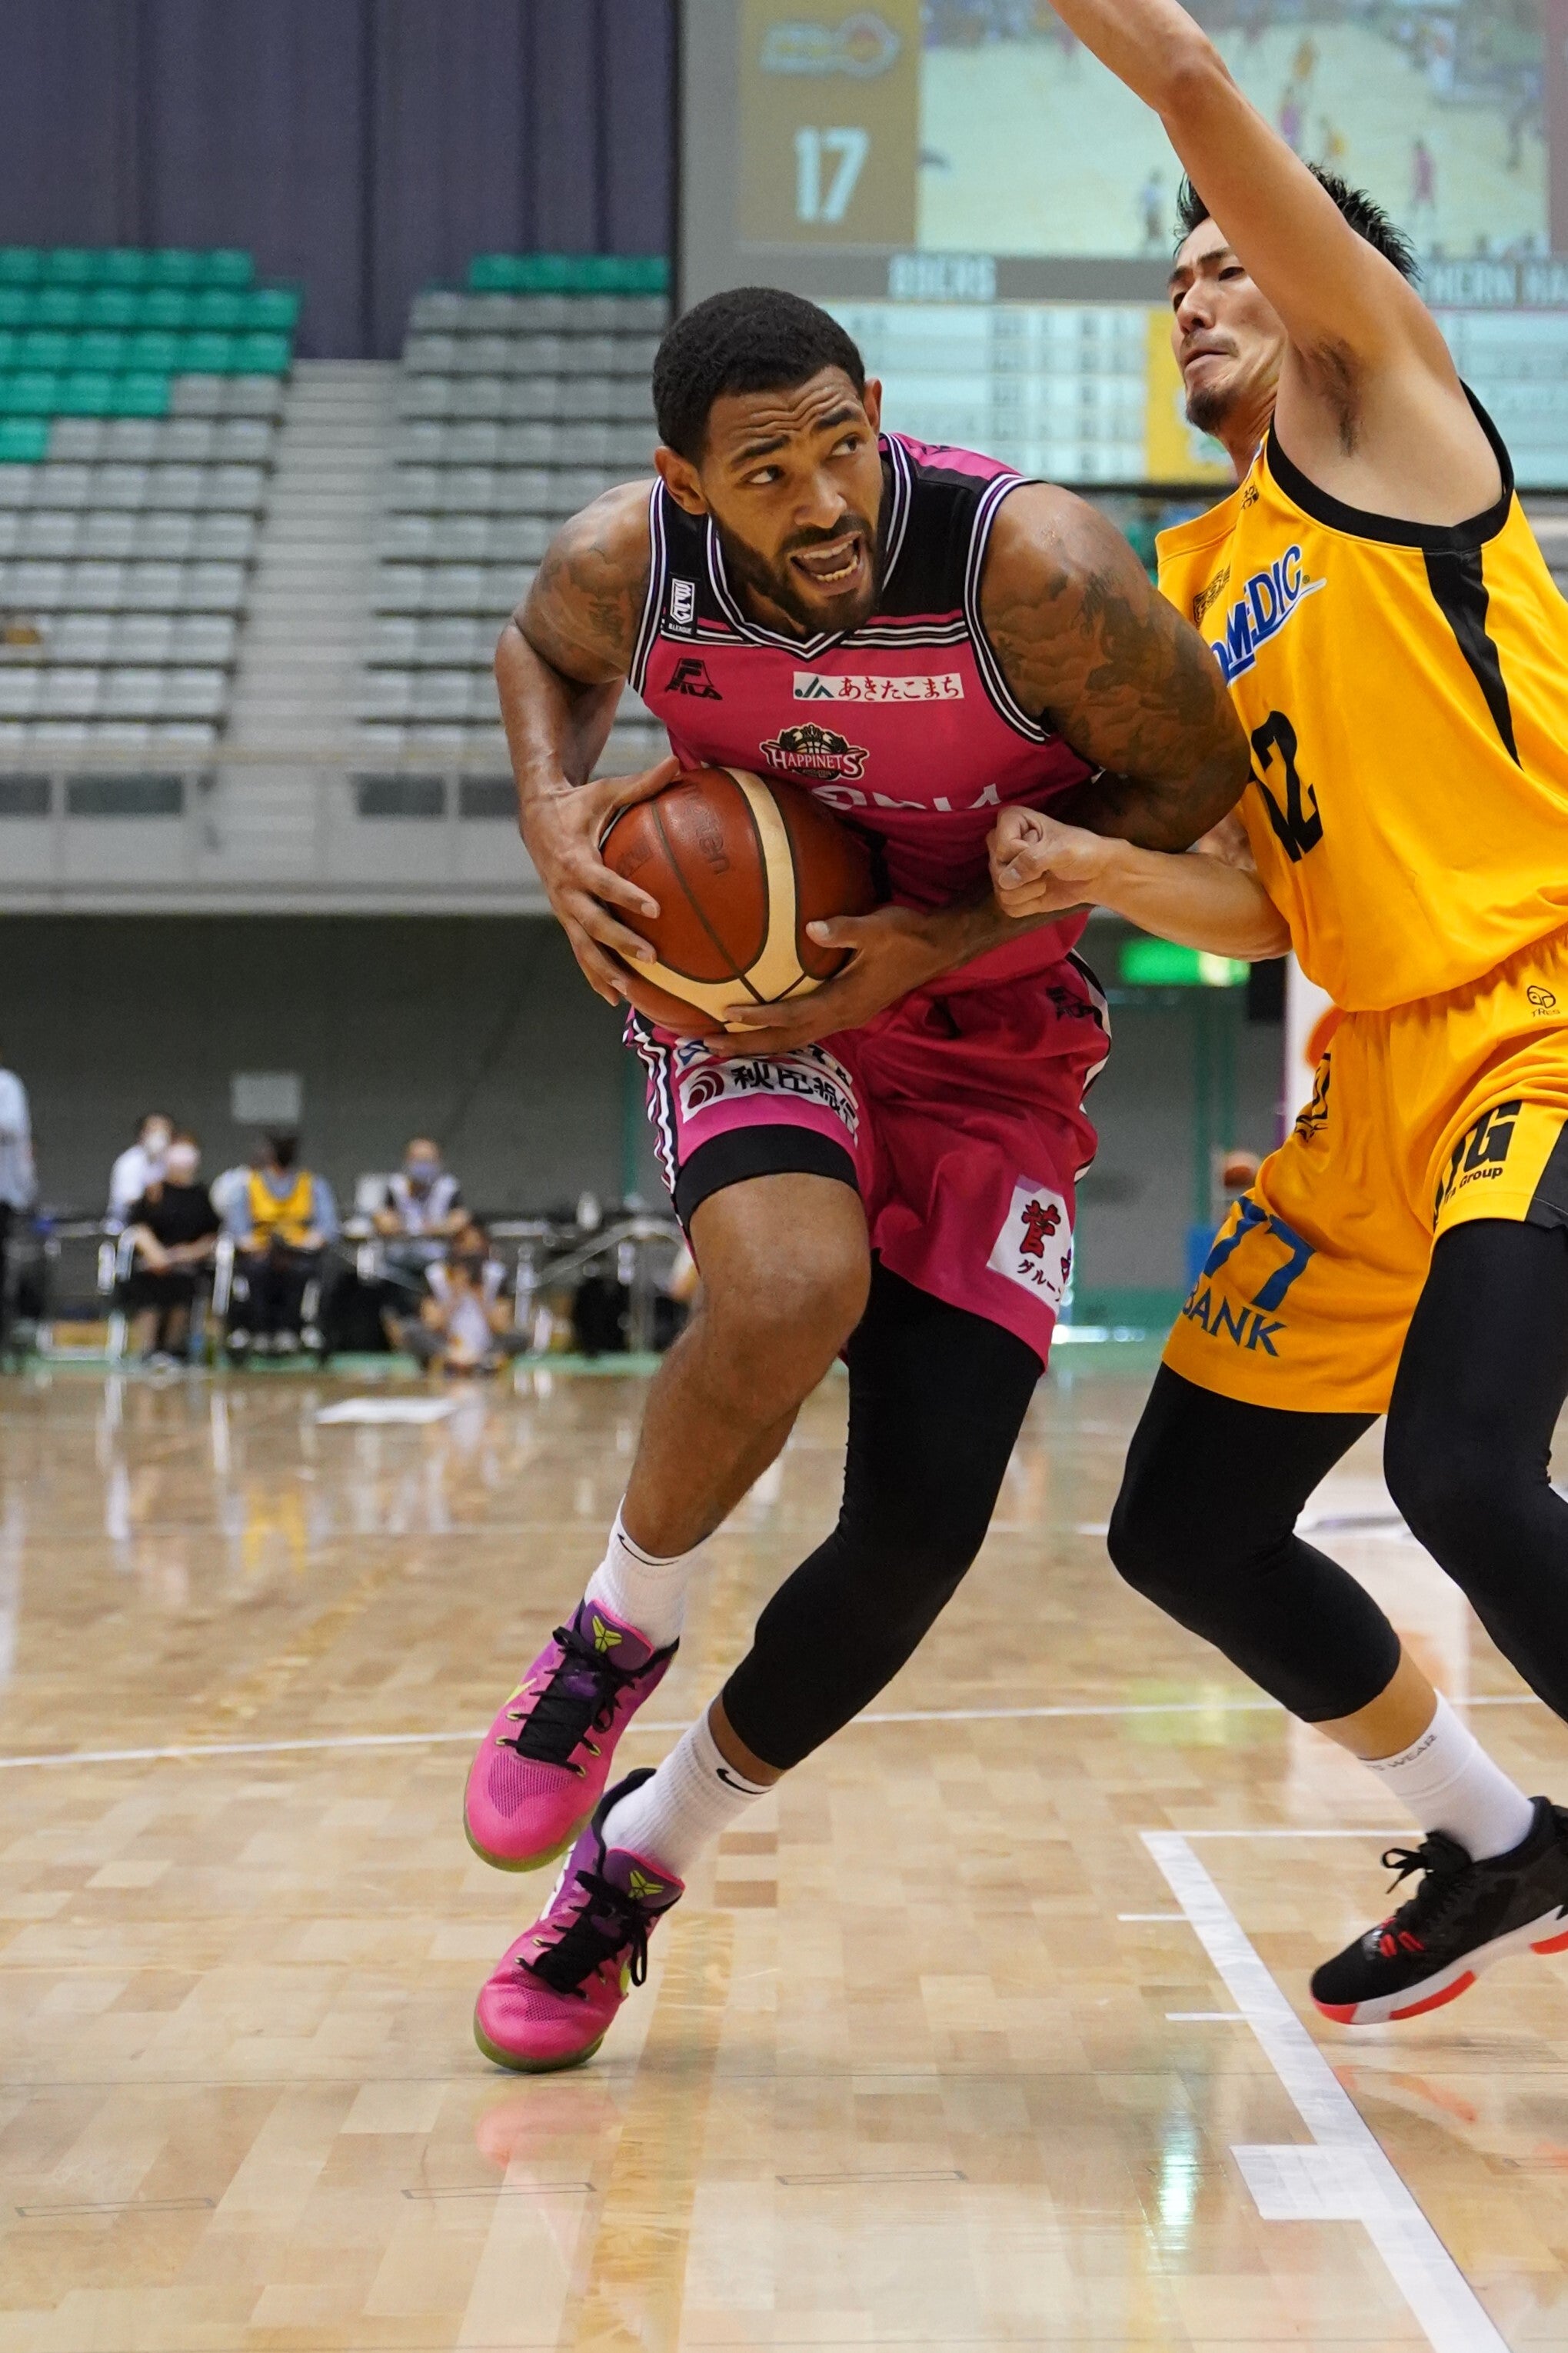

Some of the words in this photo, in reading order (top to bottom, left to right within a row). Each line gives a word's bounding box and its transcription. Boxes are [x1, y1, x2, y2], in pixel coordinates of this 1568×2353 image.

[794, 126, 869, 222] 17
[838, 676, 960, 701] あきたこまち
[771, 746, 861, 775] HAPPINETS
[1459, 1166, 1503, 1190] Group
[1203, 1195, 1316, 1312] 77
[1387, 1734, 1437, 1768] WEAR
